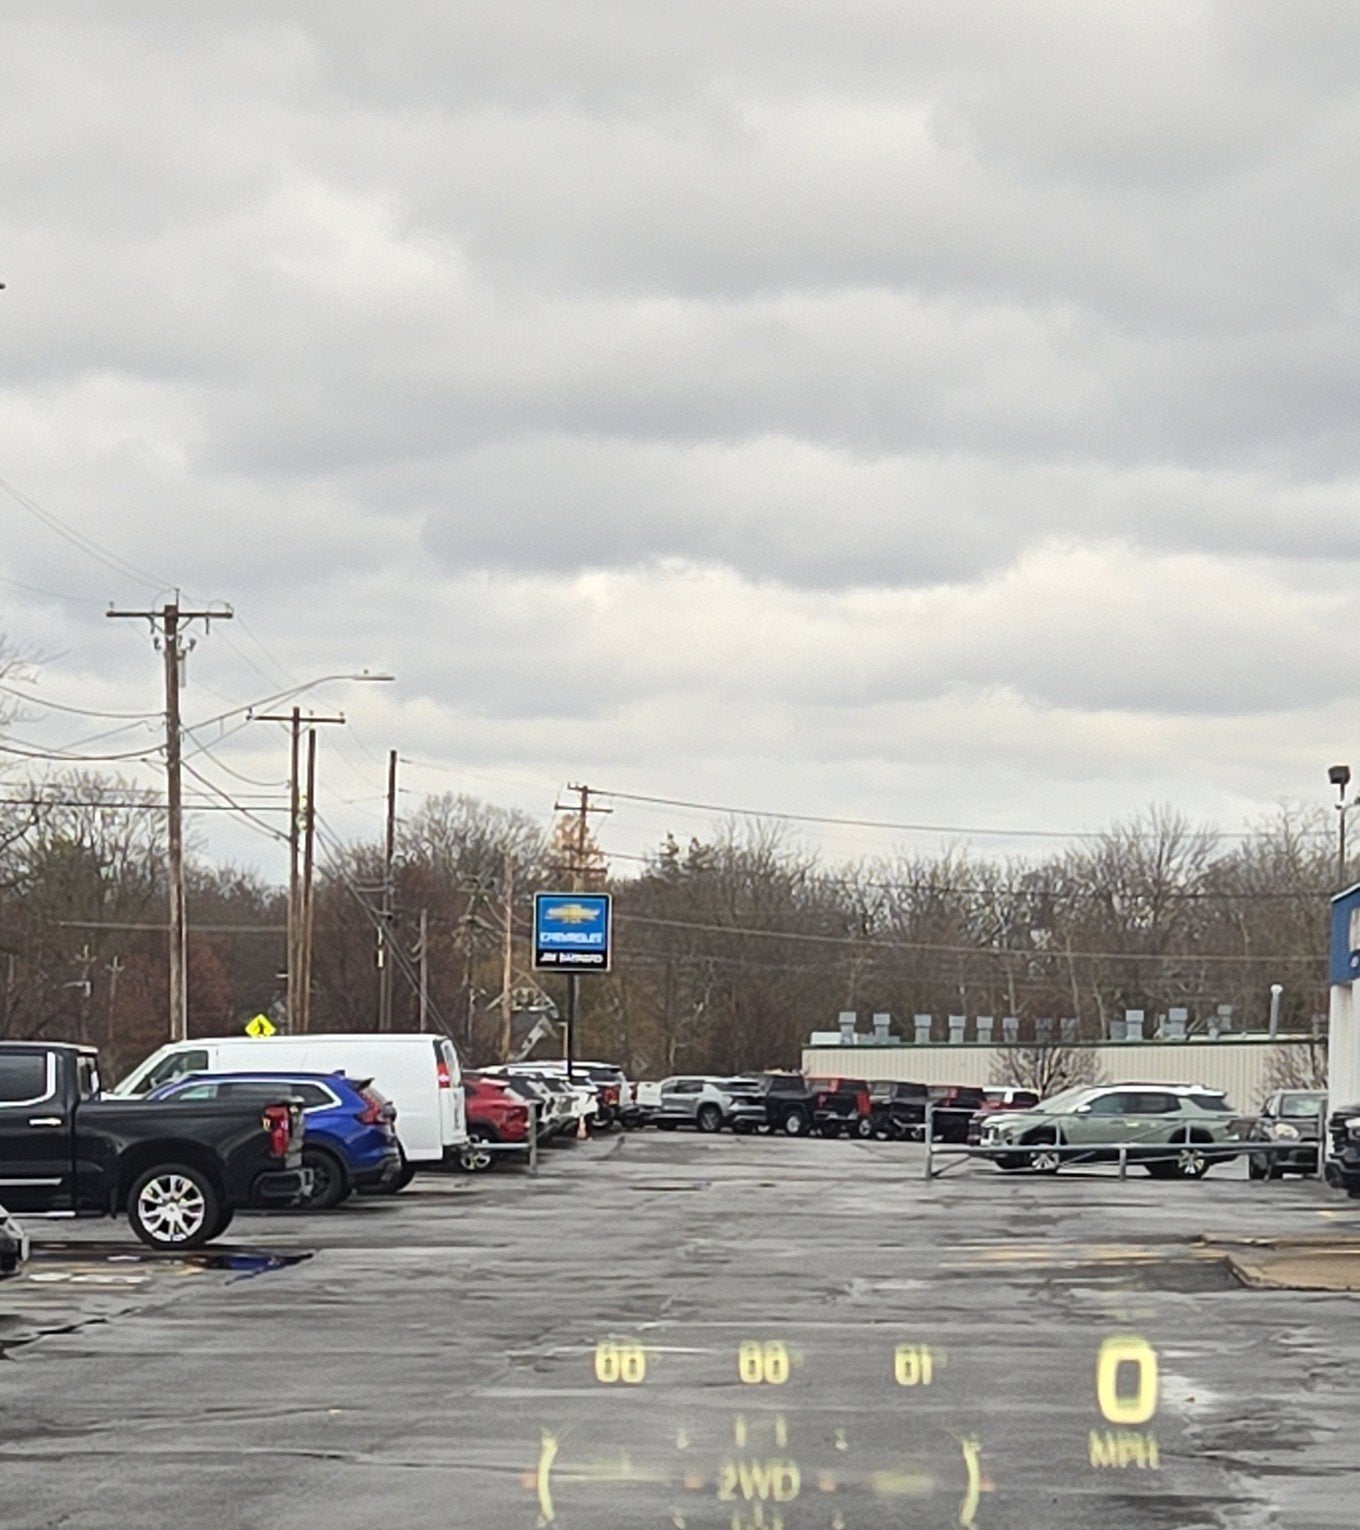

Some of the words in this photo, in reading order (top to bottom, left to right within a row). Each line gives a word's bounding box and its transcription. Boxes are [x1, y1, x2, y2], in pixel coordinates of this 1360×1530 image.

[1097, 1336, 1158, 1425] 0
[1090, 1430, 1159, 1470] MPH
[717, 1457, 801, 1502] 2WD
